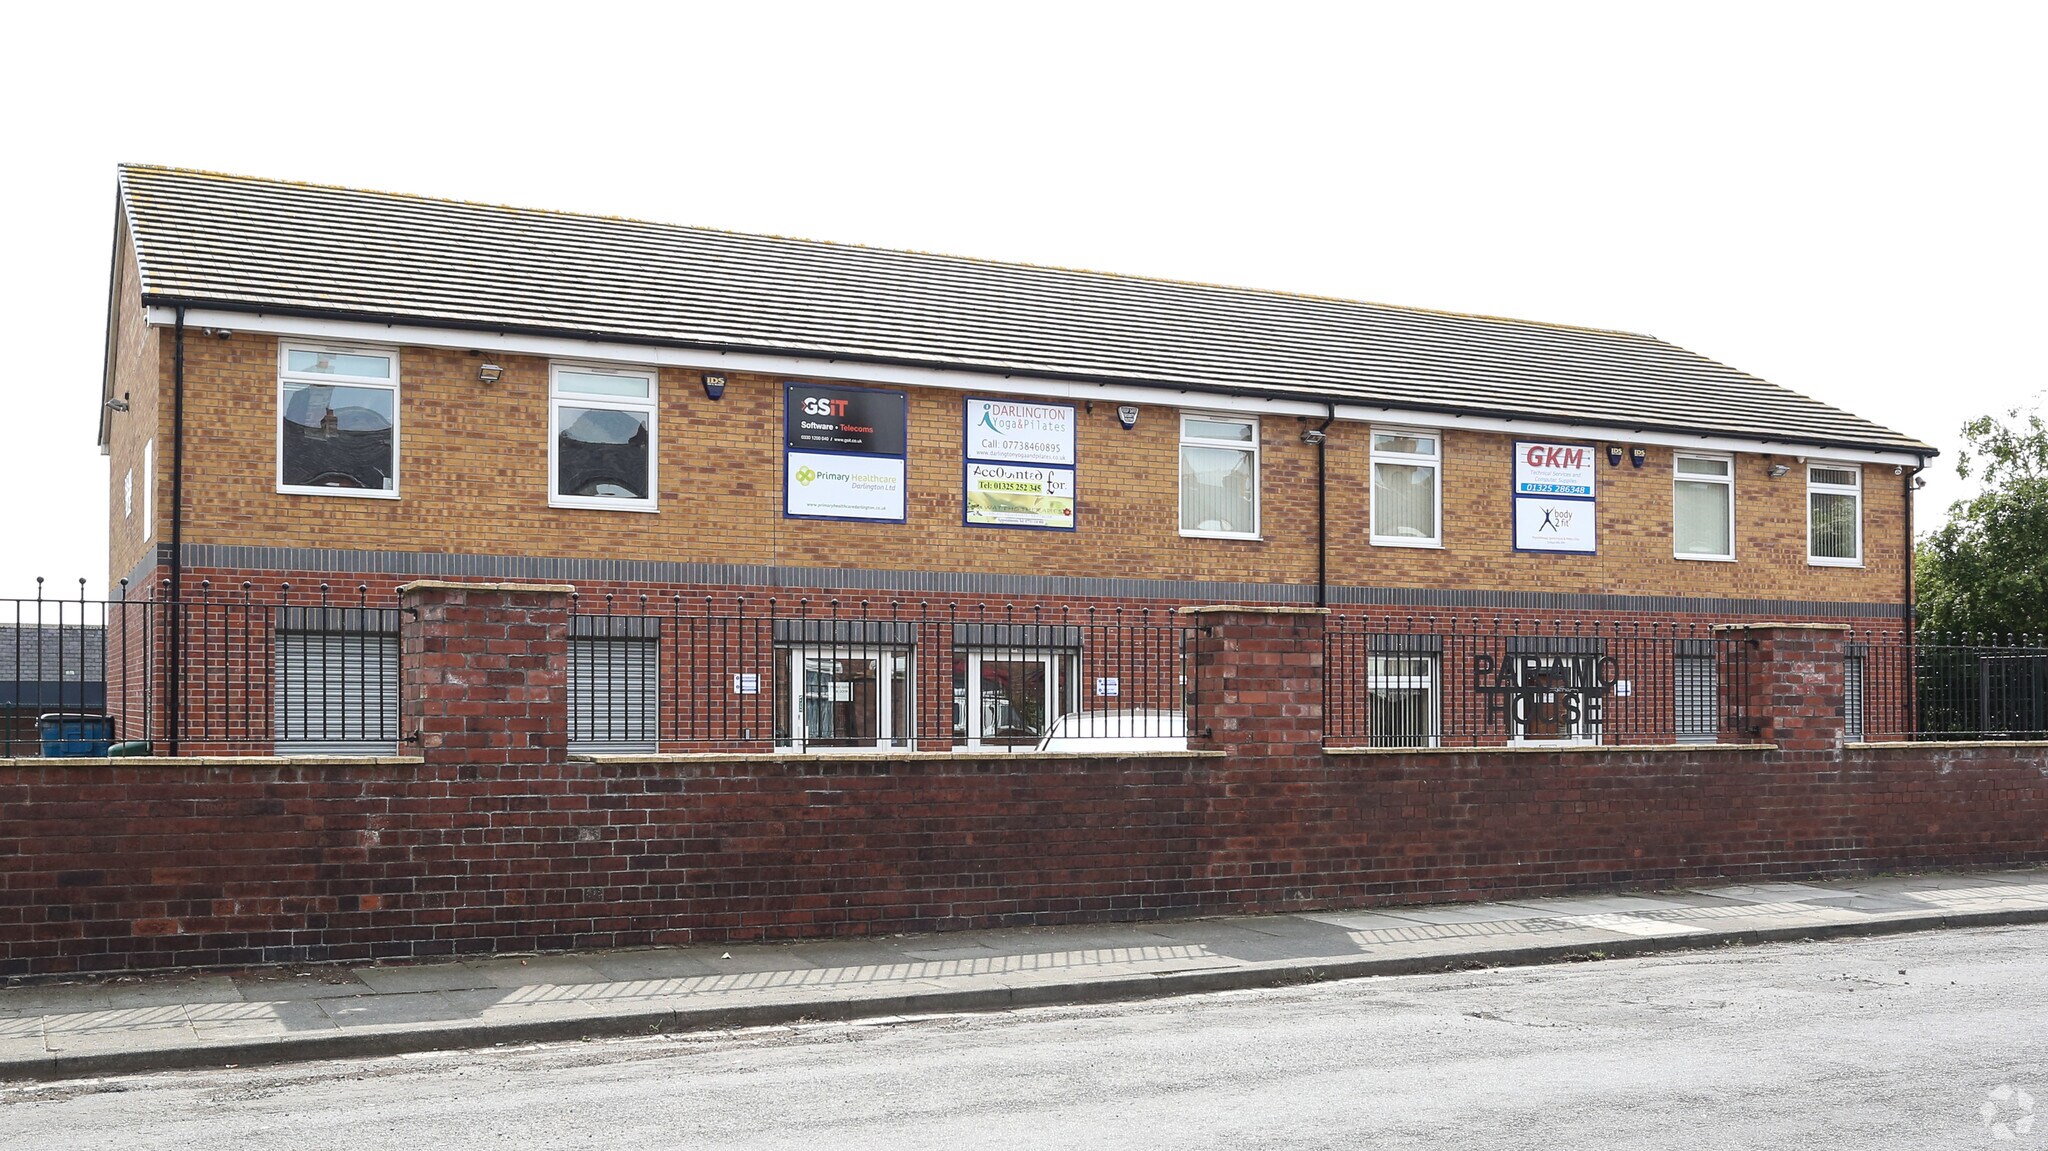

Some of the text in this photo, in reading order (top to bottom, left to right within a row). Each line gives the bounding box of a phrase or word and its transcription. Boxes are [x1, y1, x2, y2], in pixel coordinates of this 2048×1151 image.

[804, 397, 848, 417] GSiT
[992, 404, 1066, 420] DARLINGTON
[801, 421, 873, 434] Software Telecoms
[992, 417, 1066, 432] Yoga&Pilates
[982, 439, 1061, 453] Call: 07738460895
[976, 450, 1066, 461] www.darlingtonyogaandpilates.co.uk
[1526, 445, 1584, 470] GKM
[817, 471, 897, 483] Primary Healthcare
[852, 482, 885, 492] Darlington
[979, 481, 1041, 492] Tel: 01325 252 345
[1526, 484, 1585, 493] 01325 286348
[1554, 509, 1573, 520] body
[1554, 518, 1570, 528] 2 fit
[1474, 654, 1619, 688] PARAMO
[1487, 691, 1603, 725] HOUSE
